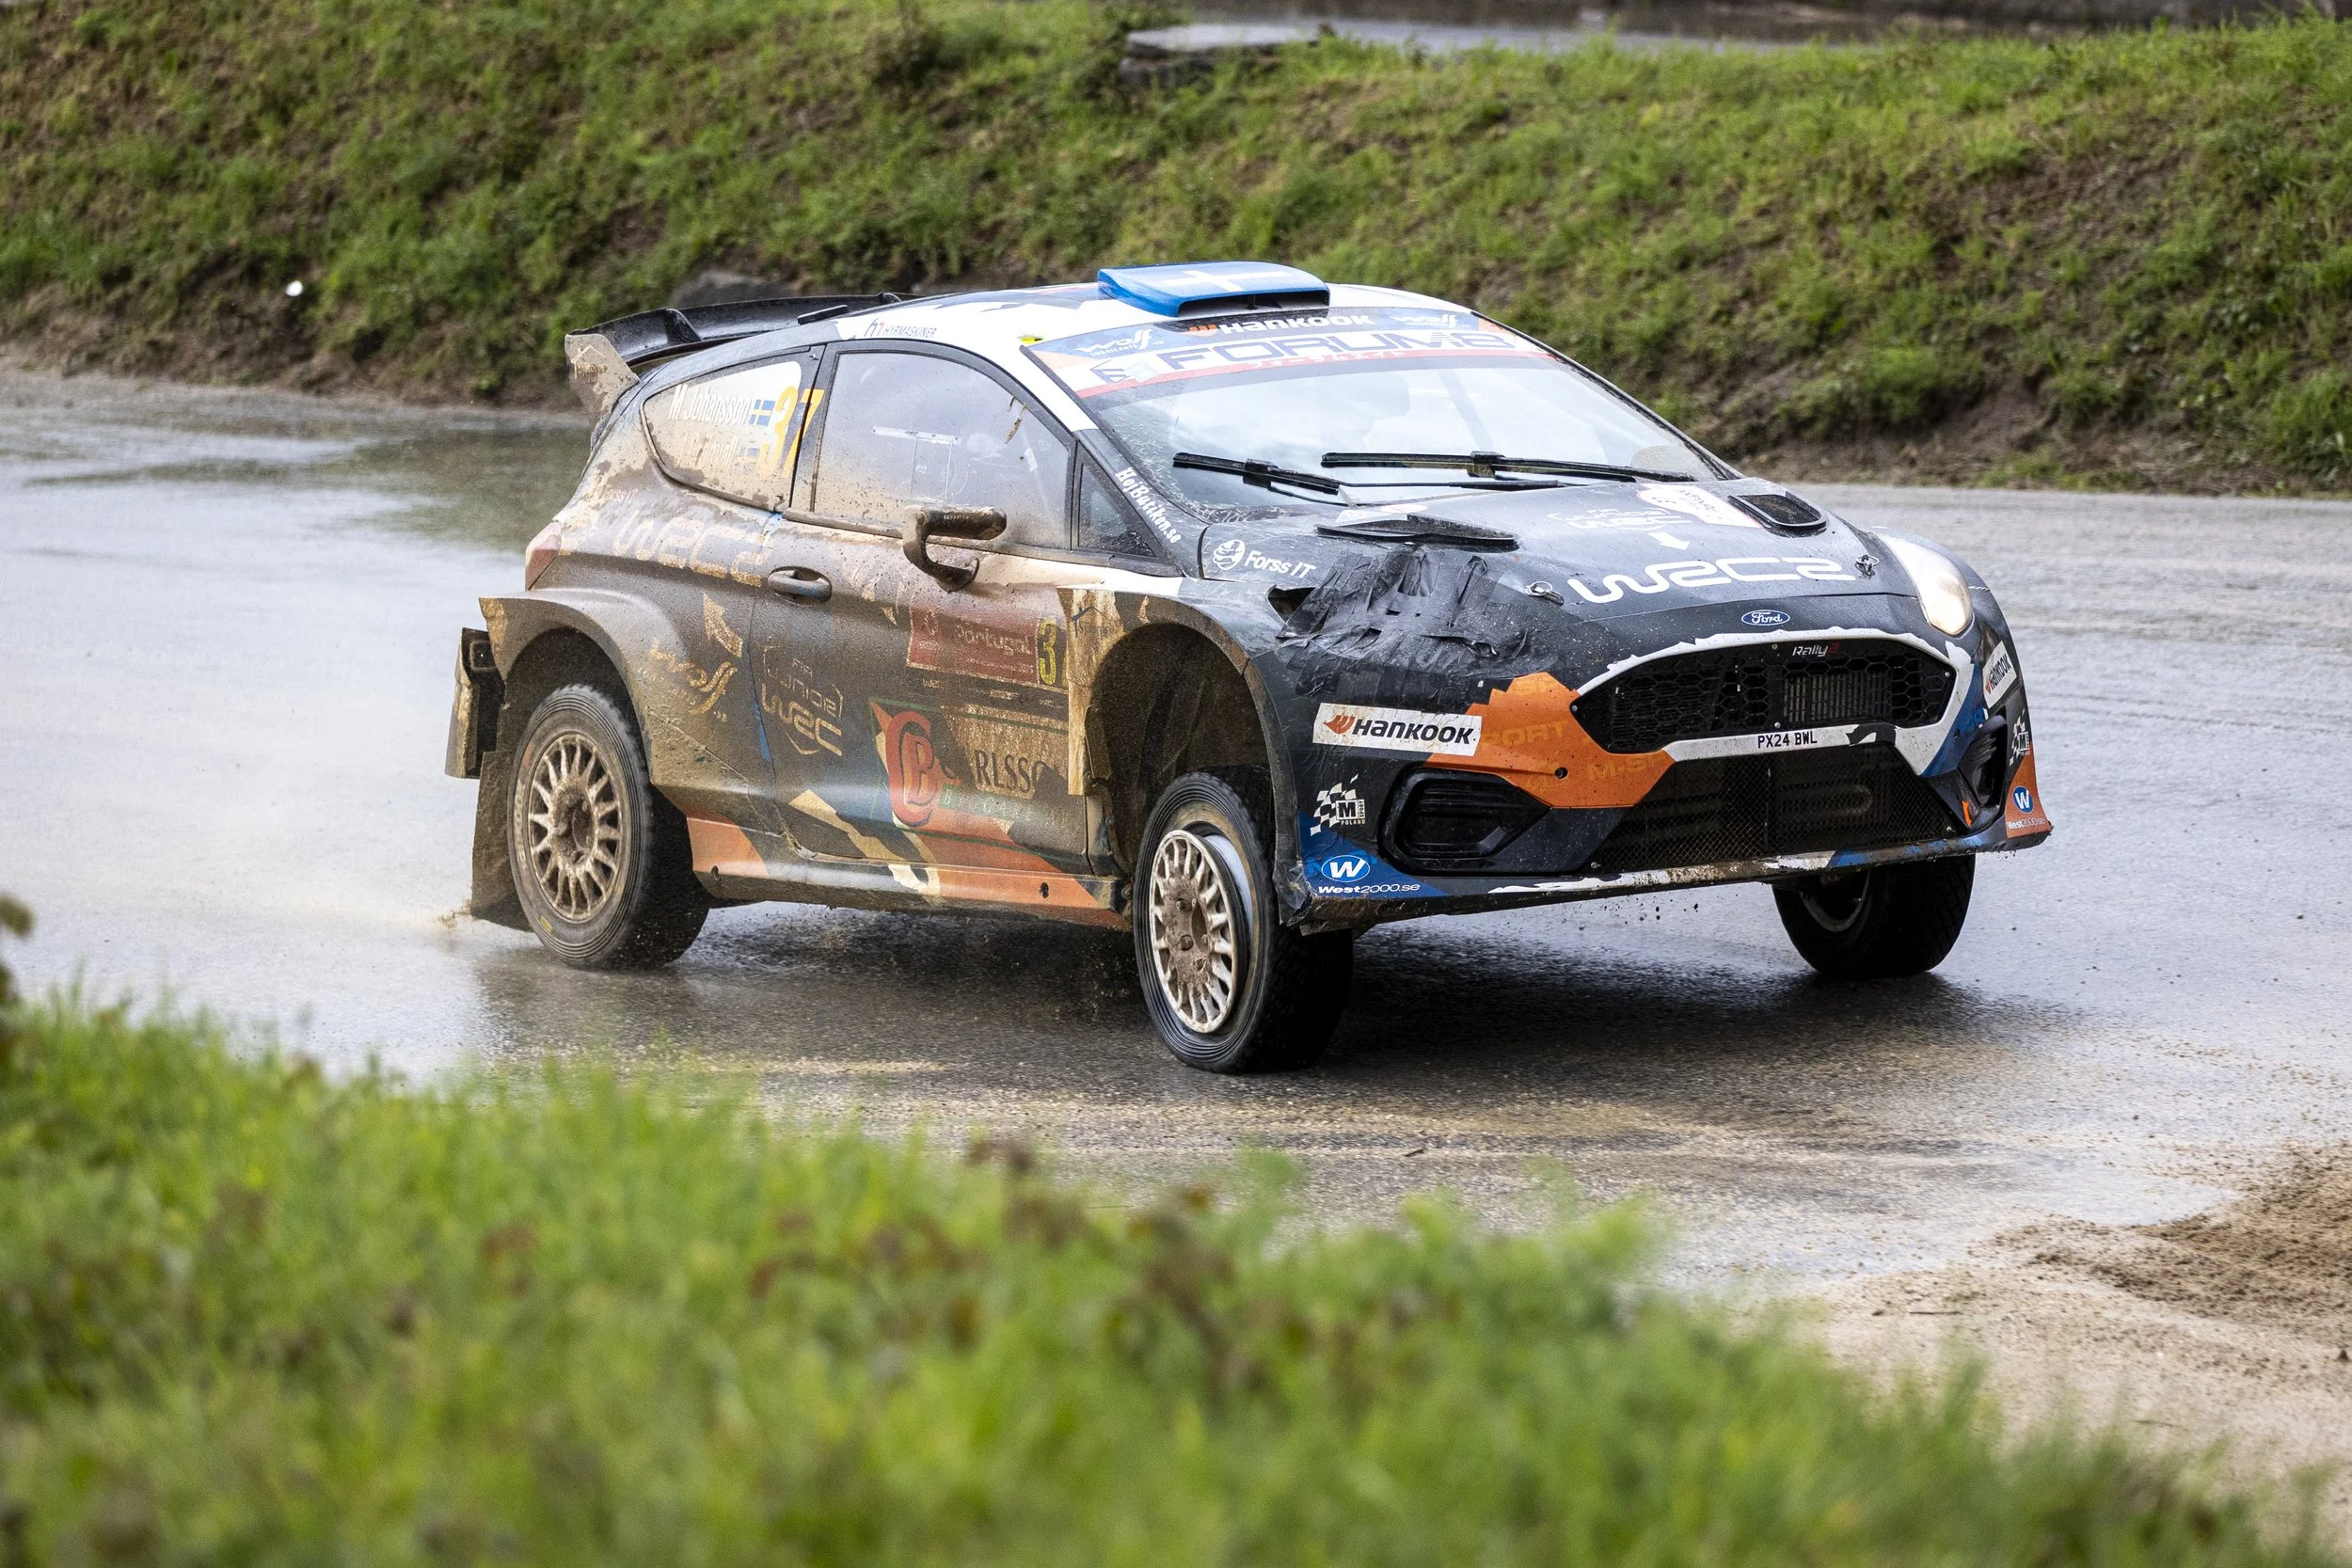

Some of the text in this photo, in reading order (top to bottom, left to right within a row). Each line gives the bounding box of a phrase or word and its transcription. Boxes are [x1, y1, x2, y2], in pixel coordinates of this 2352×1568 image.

[1217, 315, 1377, 335] HANKOOK
[1156, 331, 1516, 371] FORUM8
[758, 386, 825, 479] 37
[1244, 550, 1317, 579] Forss IT
[1566, 557, 1856, 604] WRC2
[1751, 611, 1784, 625] Ford
[1792, 642, 1840, 657] Rally2
[761, 683, 843, 757] WRC
[1352, 719, 1475, 745] HANKOOK
[1757, 731, 1819, 749] PX24 BWL
[1338, 800, 1357, 818] M
[1318, 883, 1421, 895] West2000.se
